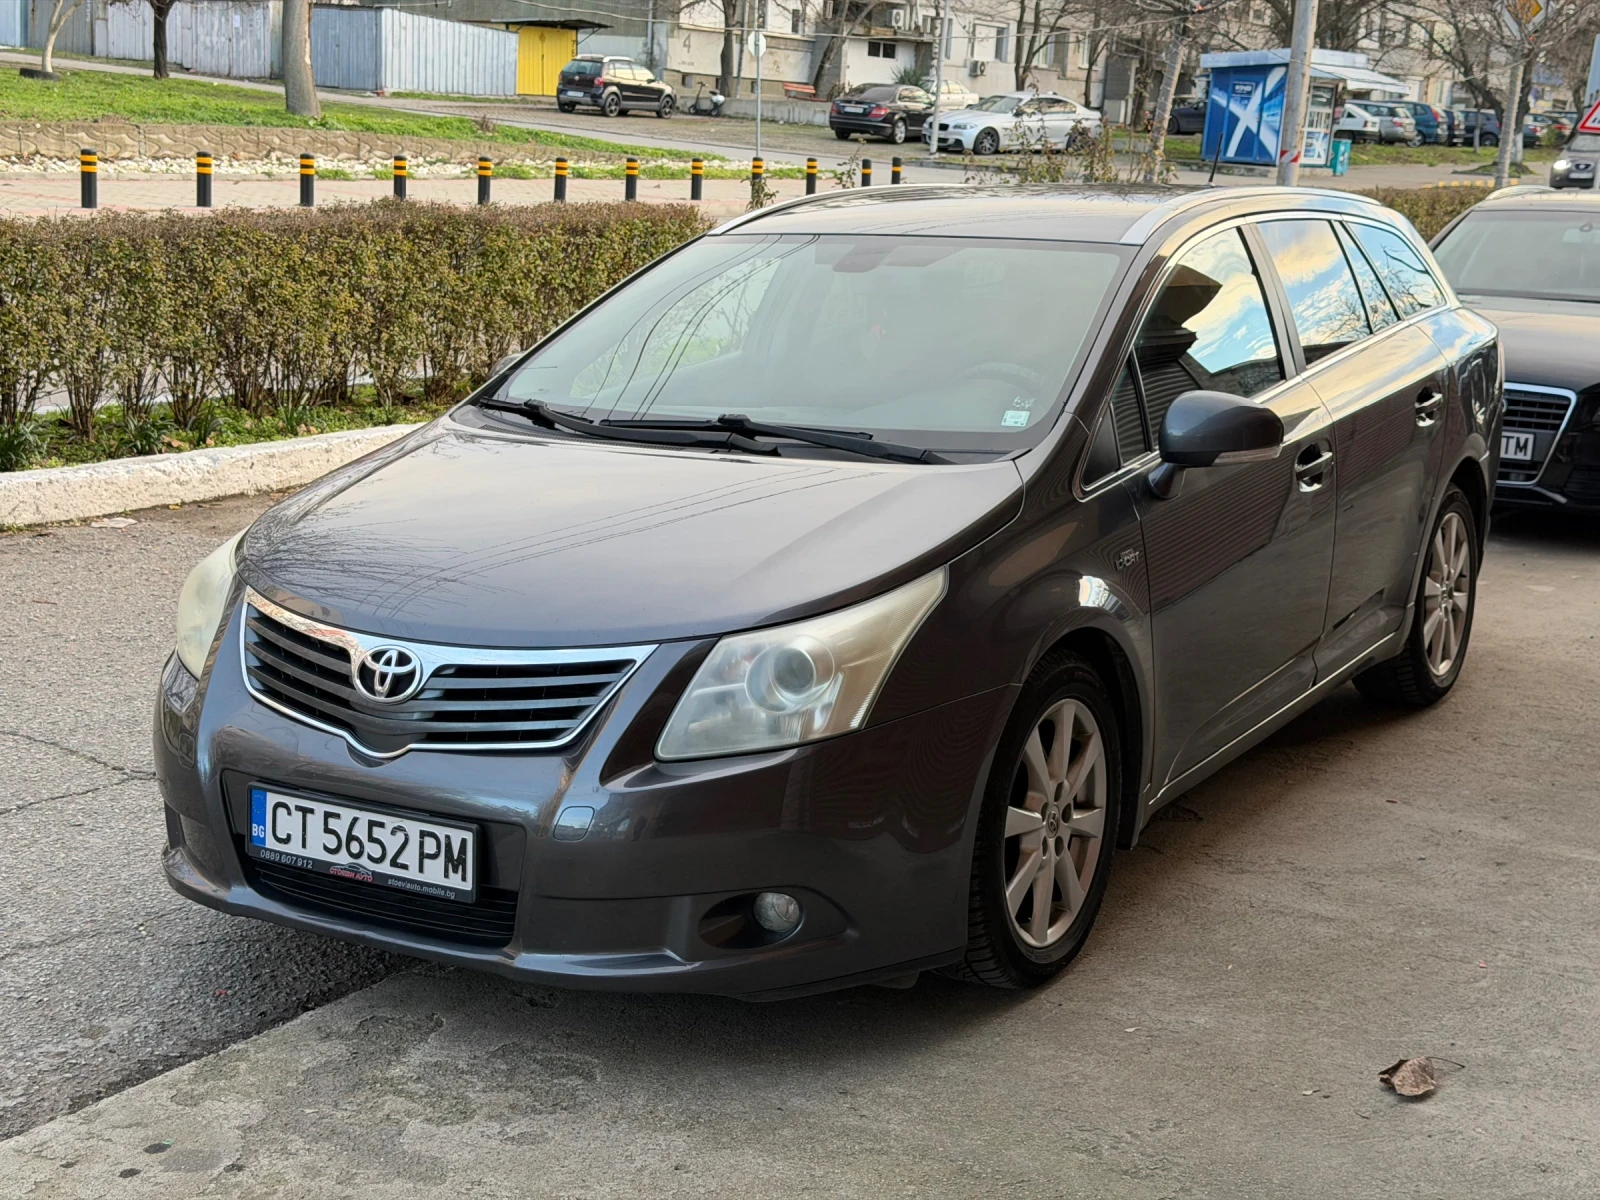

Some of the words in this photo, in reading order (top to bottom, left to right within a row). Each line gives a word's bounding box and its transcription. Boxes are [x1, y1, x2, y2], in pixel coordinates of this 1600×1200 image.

[683, 33, 691, 53] 4
[1502, 435, 1530, 457] TM
[252, 823, 265, 838] BG
[260, 849, 280, 861] 0889
